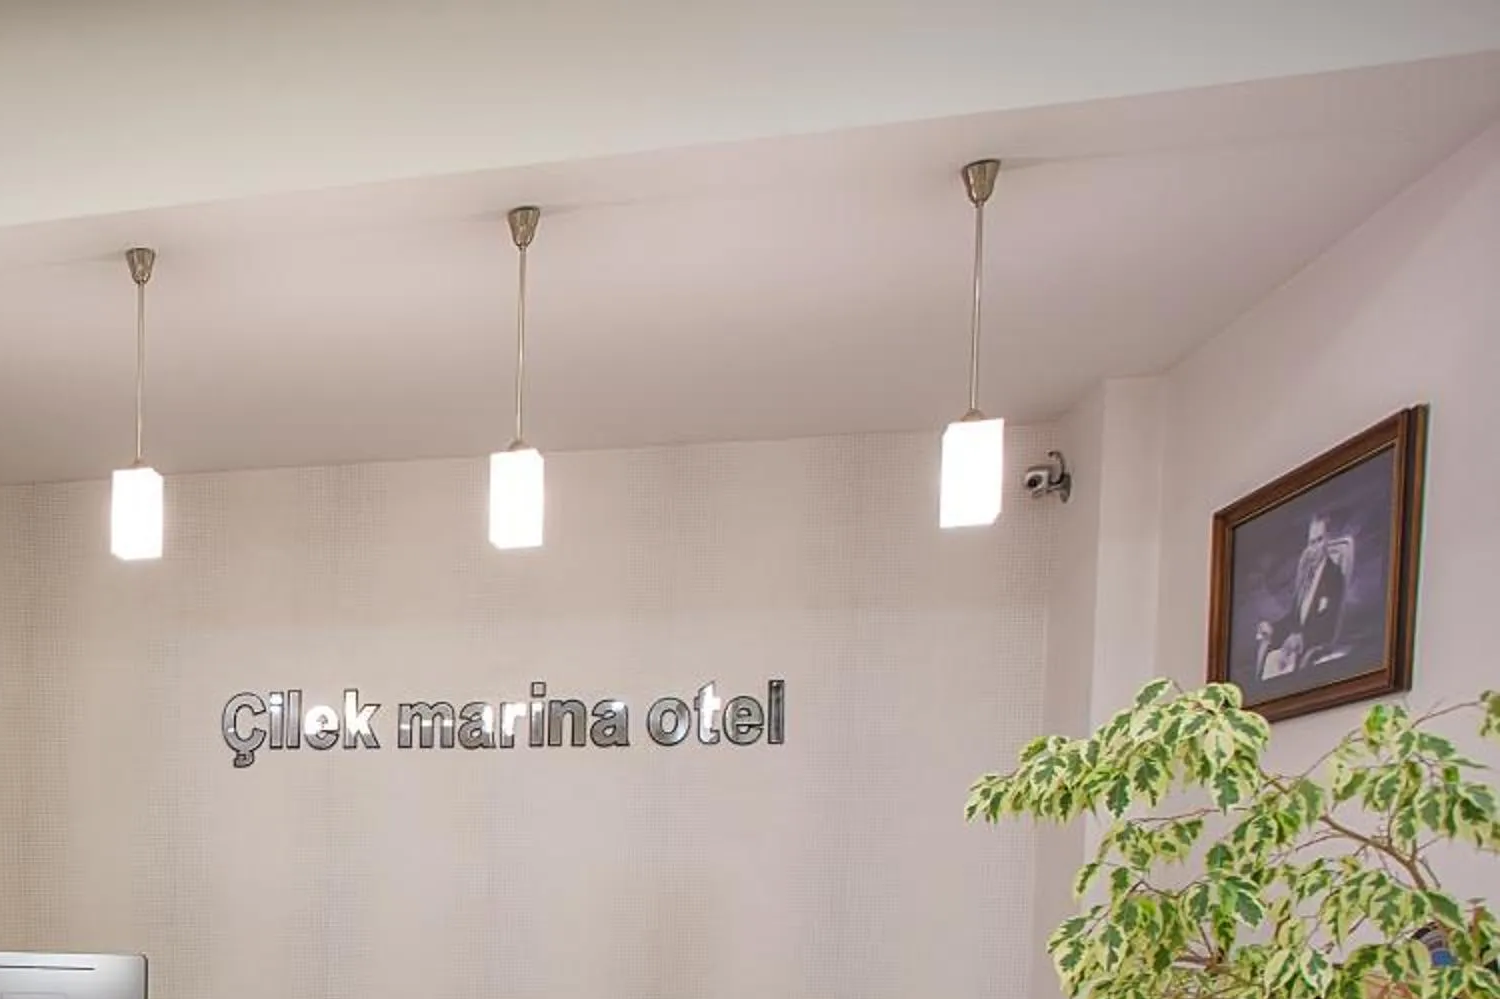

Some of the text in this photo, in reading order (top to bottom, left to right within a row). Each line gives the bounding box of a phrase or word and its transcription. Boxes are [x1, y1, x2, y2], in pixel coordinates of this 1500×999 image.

[221, 679, 785, 768] Çilek marina otel
